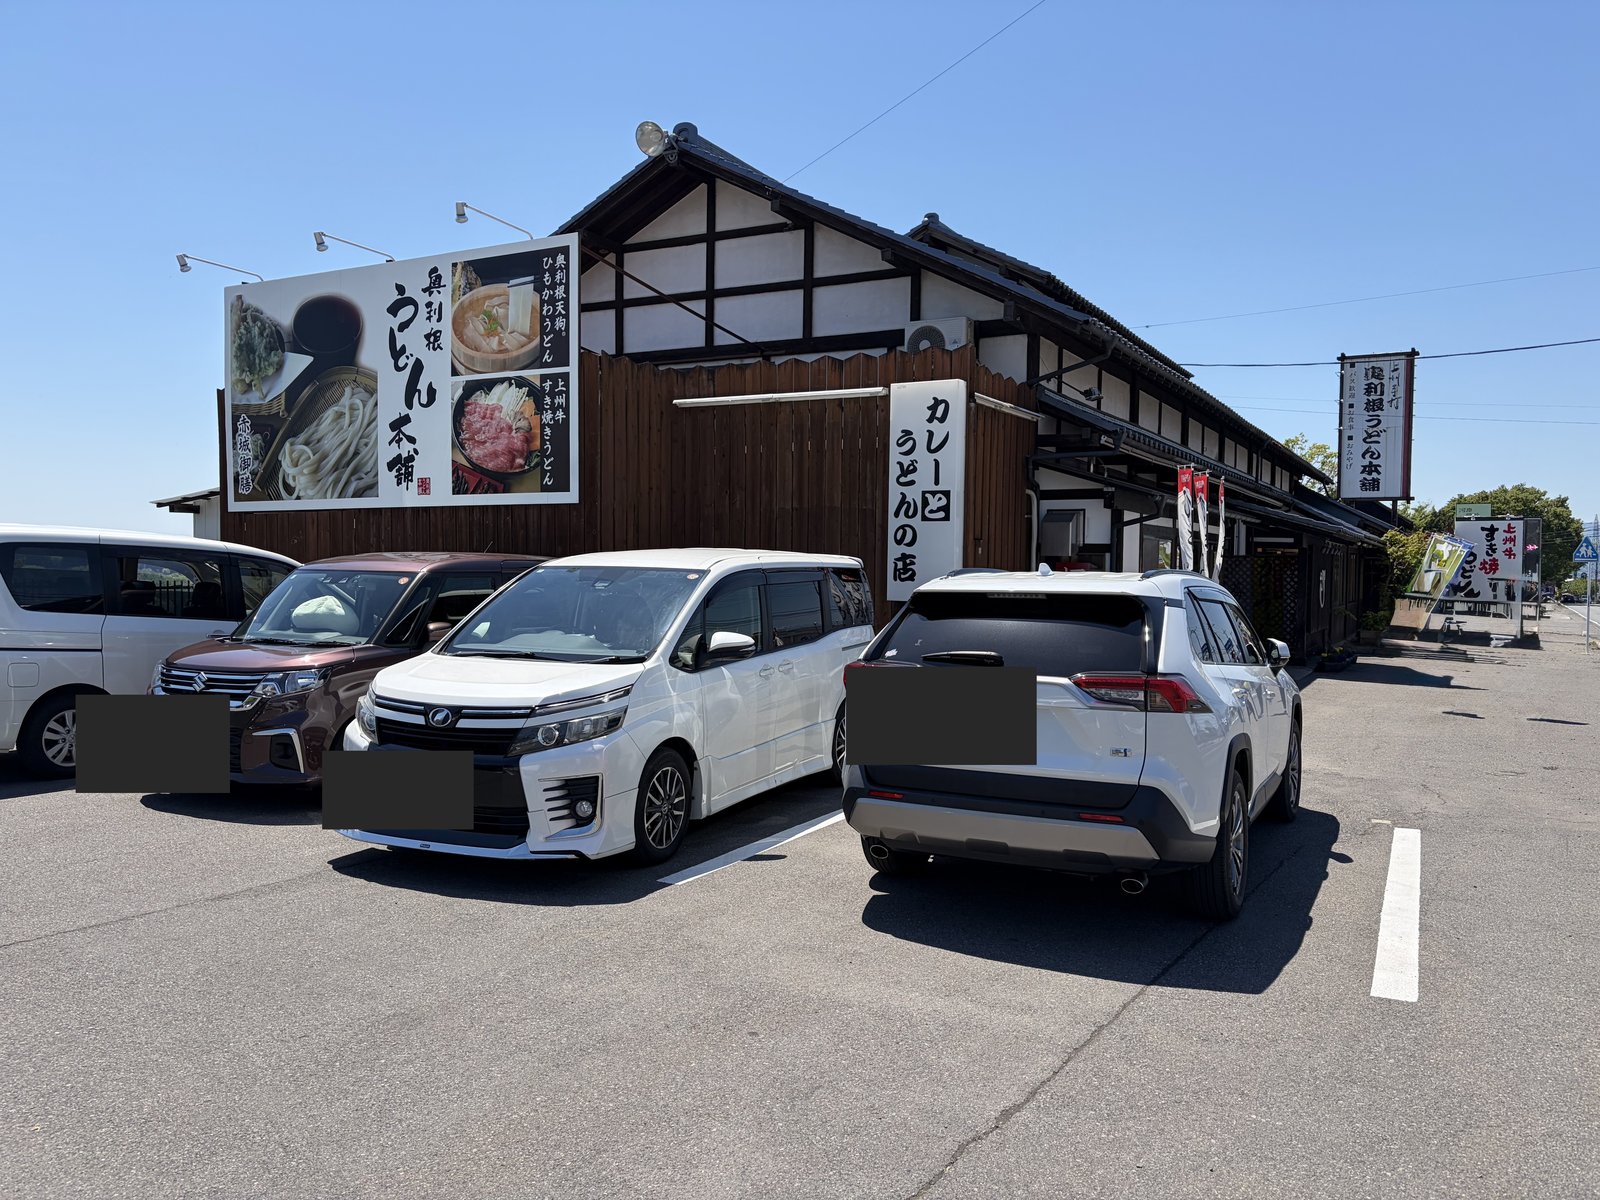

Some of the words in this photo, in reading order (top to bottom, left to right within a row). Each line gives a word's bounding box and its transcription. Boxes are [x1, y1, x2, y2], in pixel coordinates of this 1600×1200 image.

[421, 265, 447, 352] 奥利根
[542, 257, 554, 363] ひもかわうどん
[541, 379, 554, 486] すき焼きうどん
[554, 378, 567, 424] 上州牛
[236, 413, 253, 494] 赤城御膳
[923, 397, 950, 521] カレーと
[893, 429, 919, 582] うどんの店
[1501, 522, 1516, 560] 上州牛
